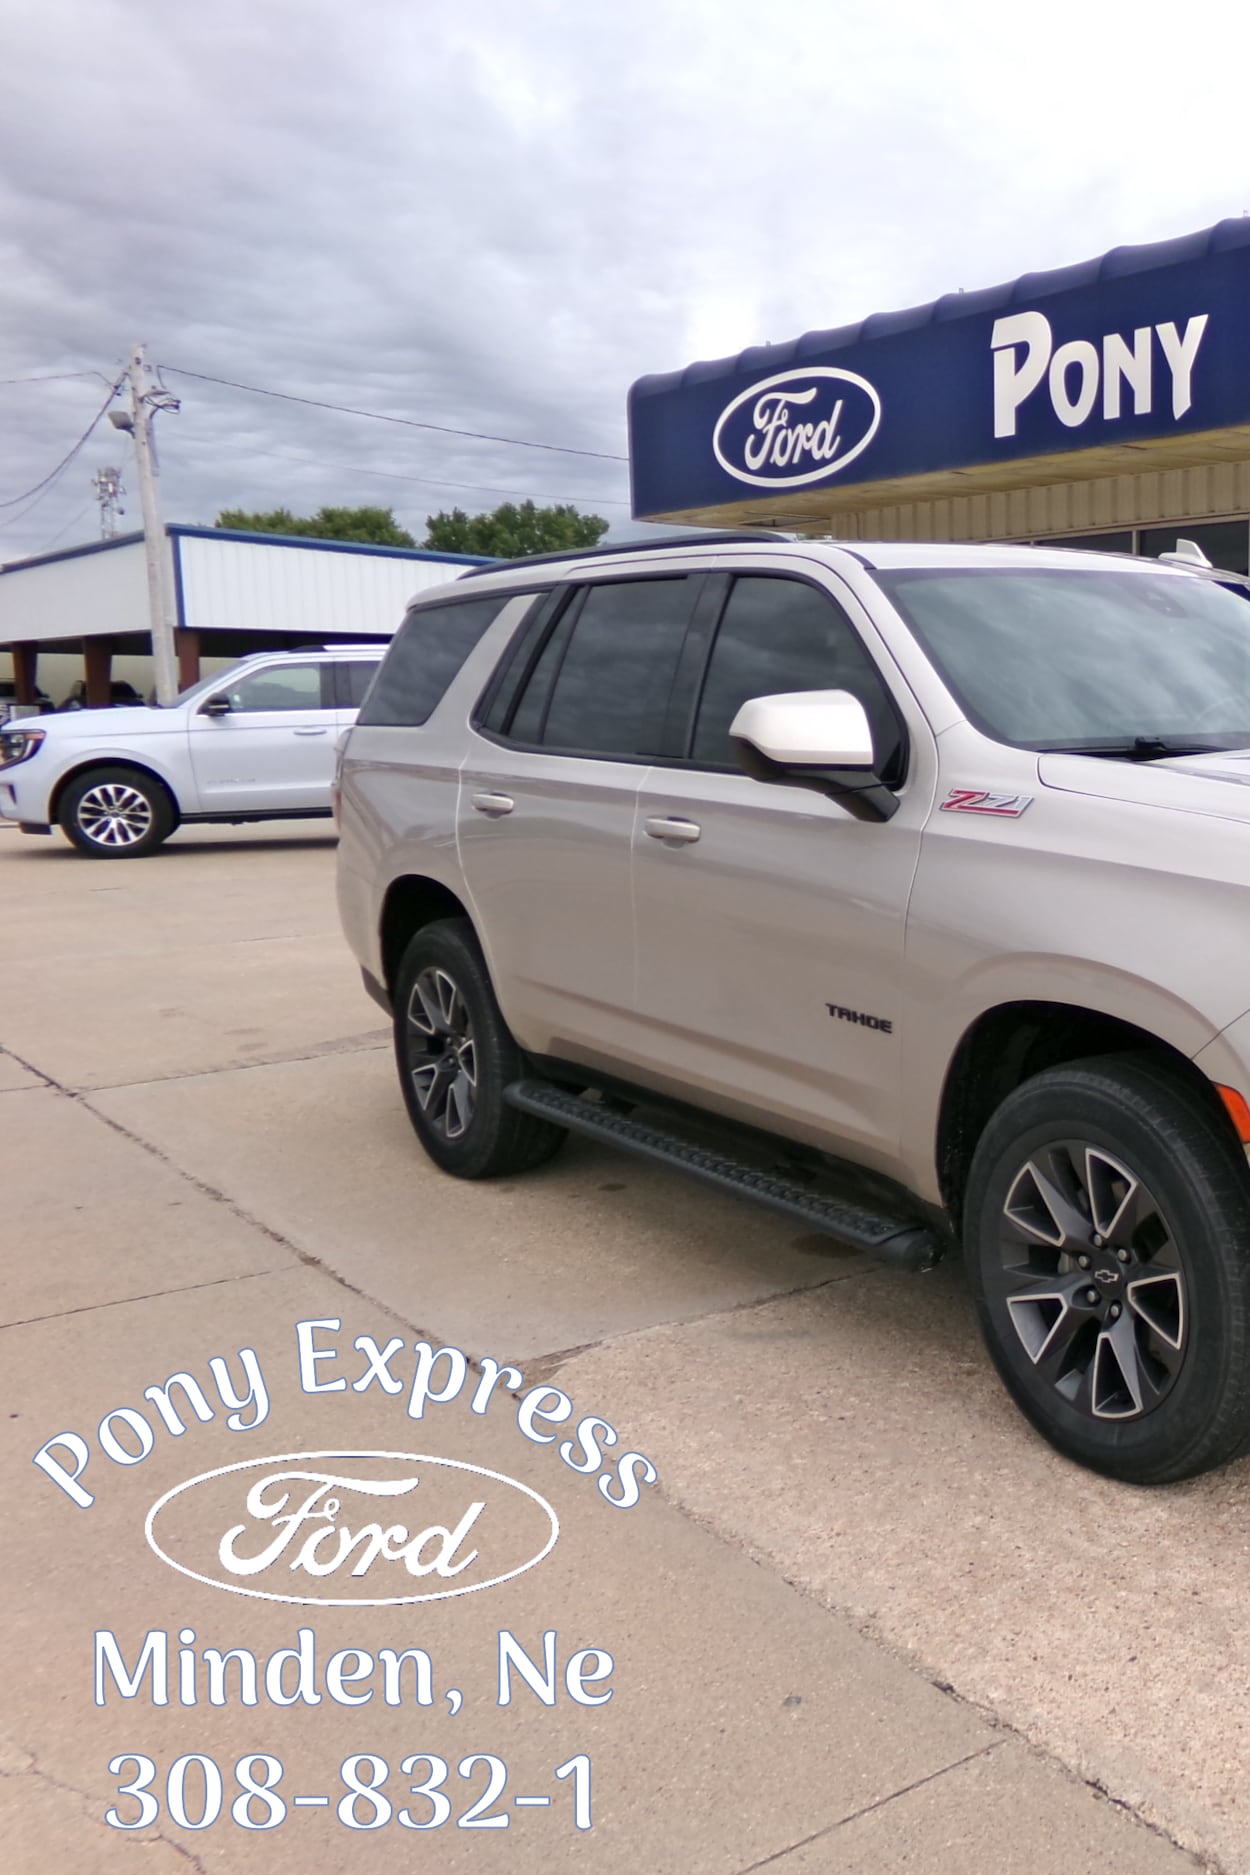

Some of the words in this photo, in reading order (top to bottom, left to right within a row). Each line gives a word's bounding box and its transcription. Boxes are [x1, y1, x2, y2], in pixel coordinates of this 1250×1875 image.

[990, 311, 1209, 438] PONY
[744, 387, 843, 471] Ford
[940, 788, 1035, 818] Z71
[825, 1003, 892, 1034] TAHOE
